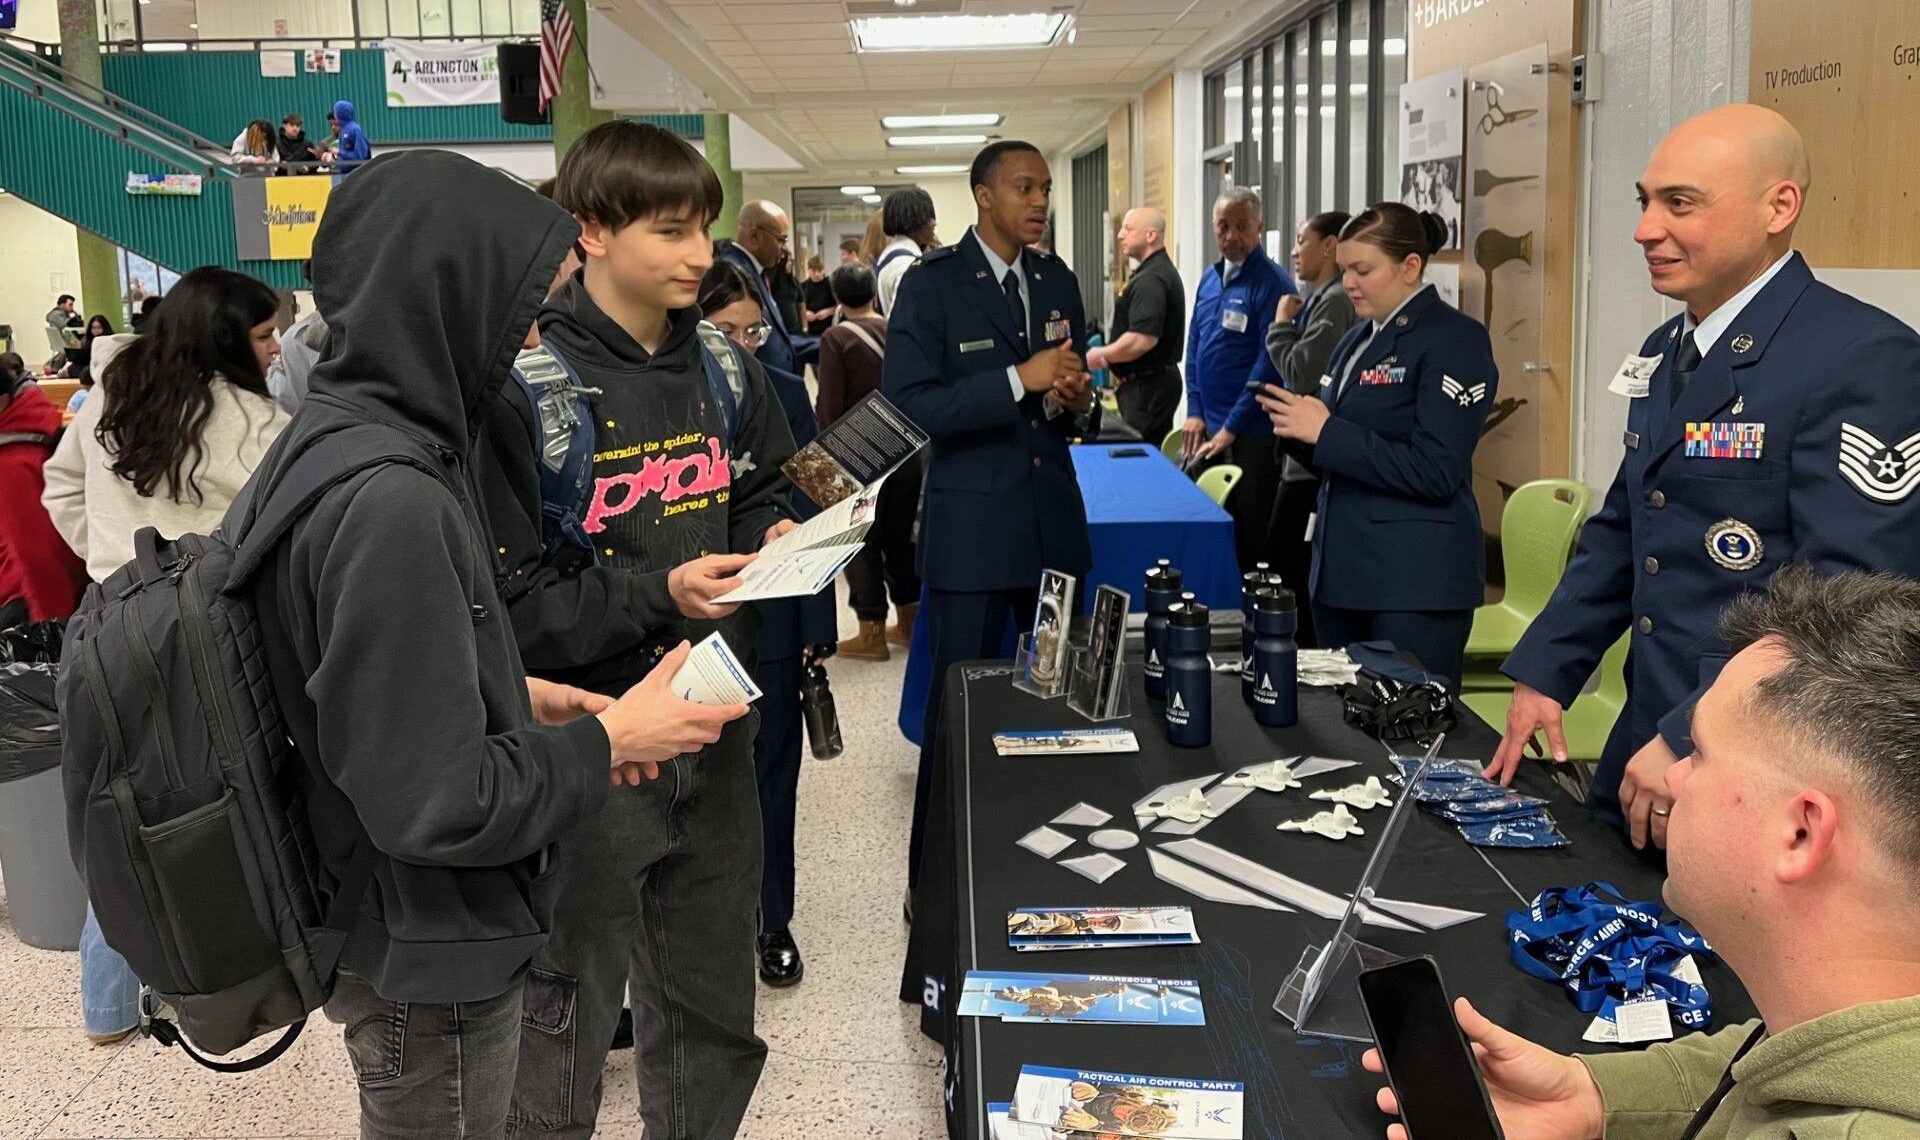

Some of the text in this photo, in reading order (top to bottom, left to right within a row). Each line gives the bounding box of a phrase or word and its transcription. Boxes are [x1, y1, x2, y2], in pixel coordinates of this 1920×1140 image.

[414, 59, 479, 76] ARLINGTON
[1765, 61, 1842, 90] TV Production
[643, 441, 659, 452] the
[664, 433, 705, 450] spider,
[1562, 938, 1595, 979] ORCE
[1089, 975, 1154, 984] PARARESCUE
[1077, 1071, 1237, 1091] TACTICAL AIR CONTROL PARTY
